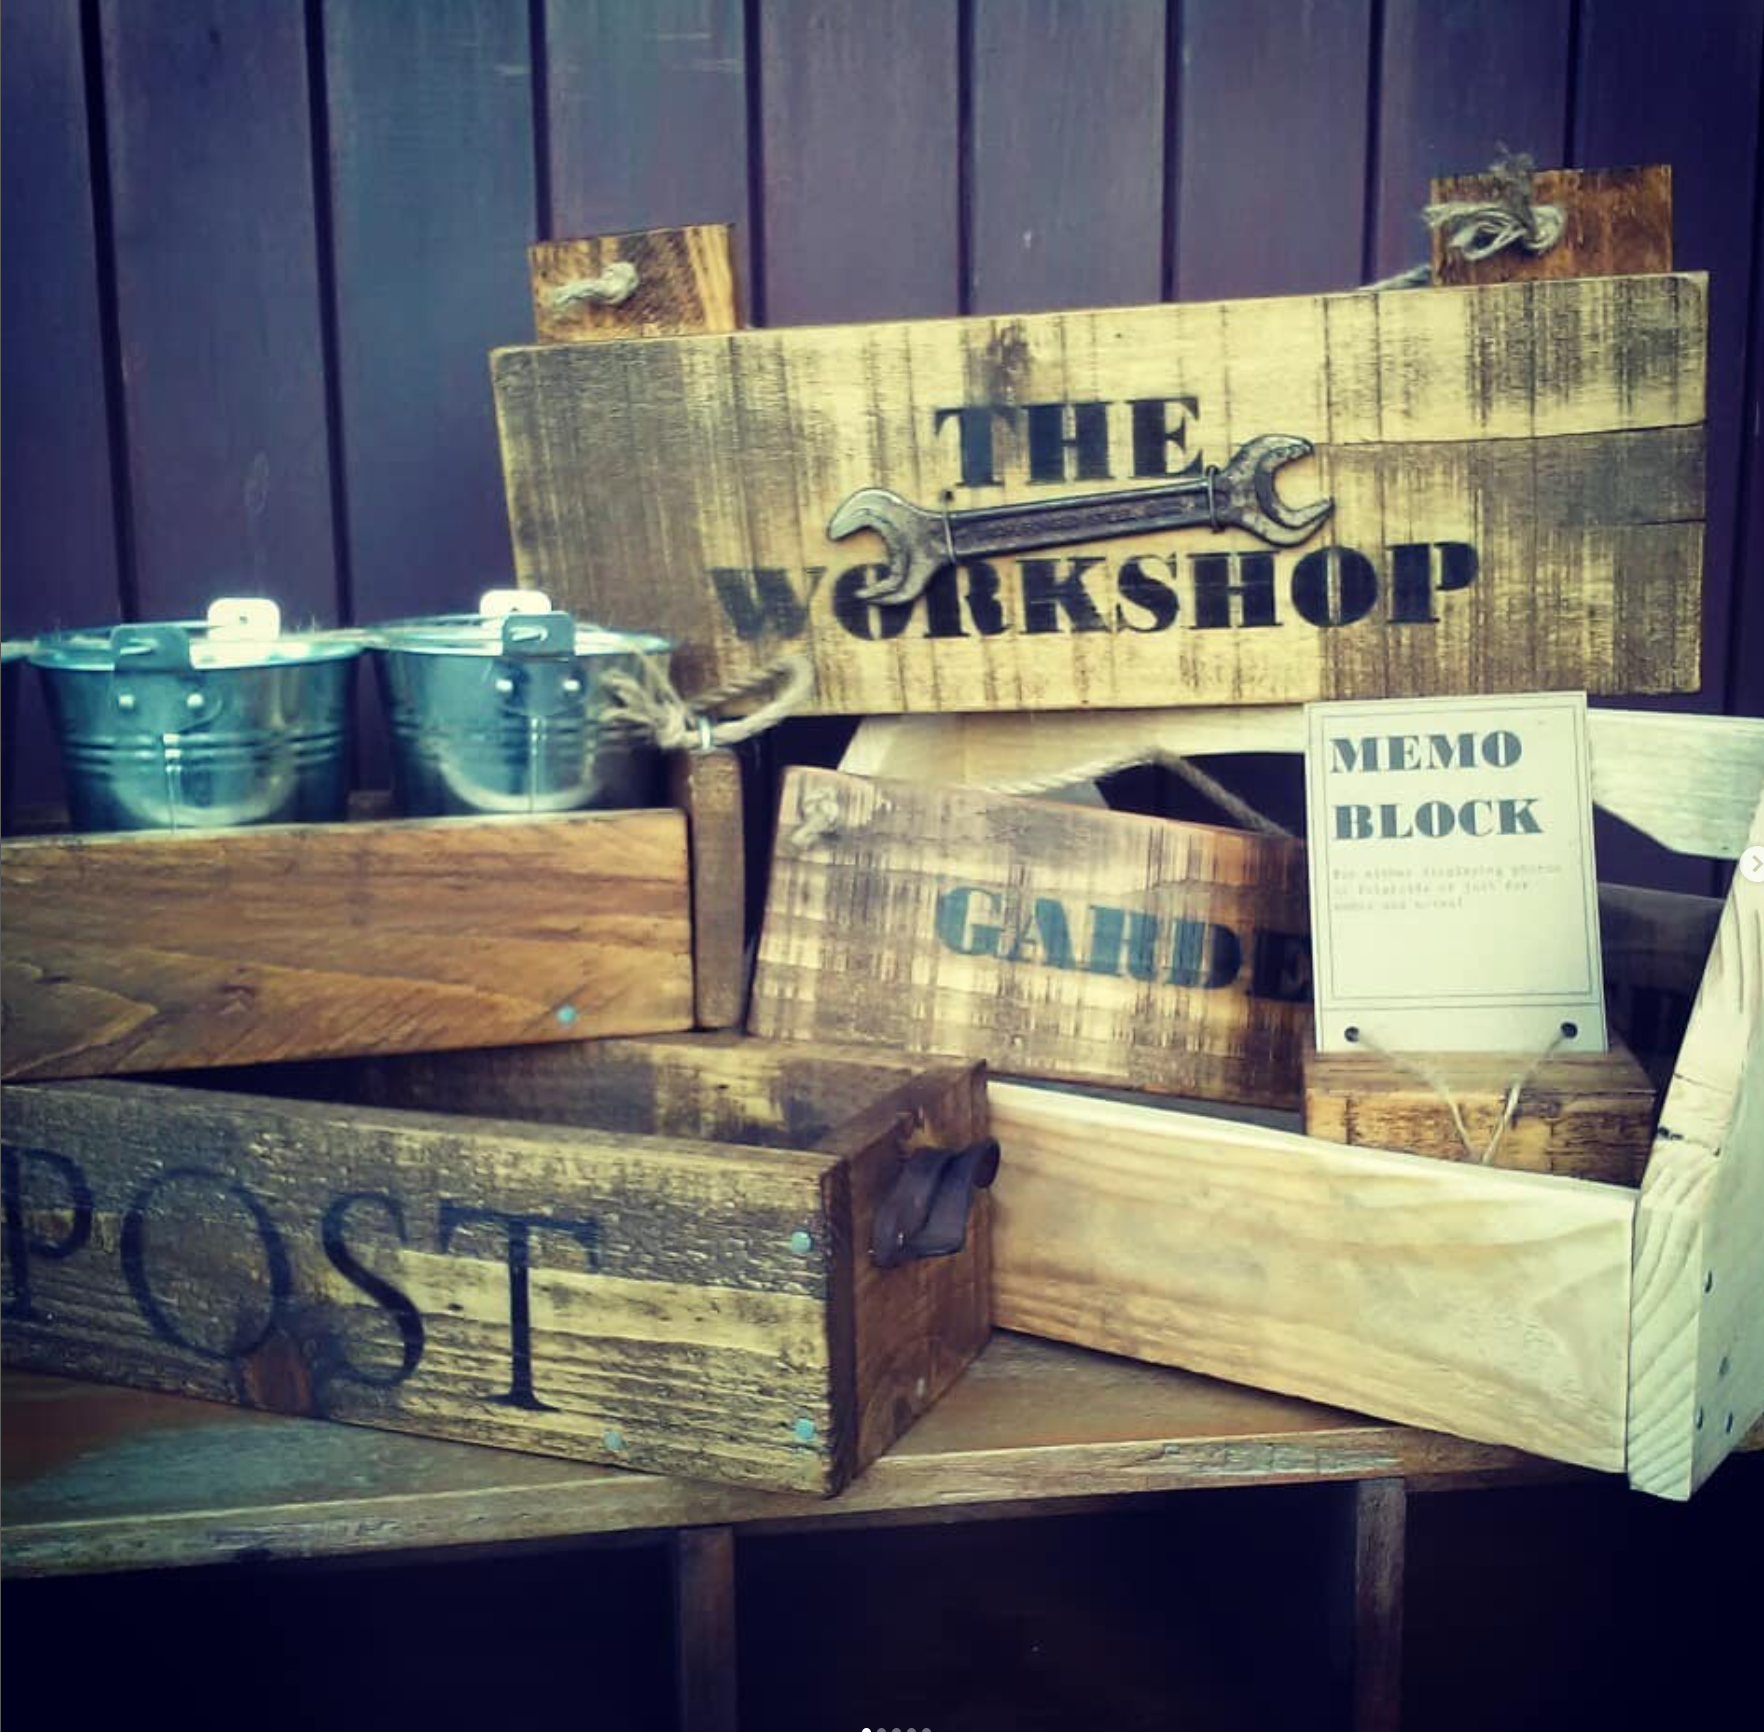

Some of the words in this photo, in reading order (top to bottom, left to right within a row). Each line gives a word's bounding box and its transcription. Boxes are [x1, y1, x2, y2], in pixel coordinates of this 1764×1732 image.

[935, 396, 1203, 487] THE
[709, 541, 1479, 640] WORKSHOP
[1330, 730, 1522, 773] MEMO
[1334, 799, 1545, 840] BLOCK
[0, 1143, 605, 1412] POST
